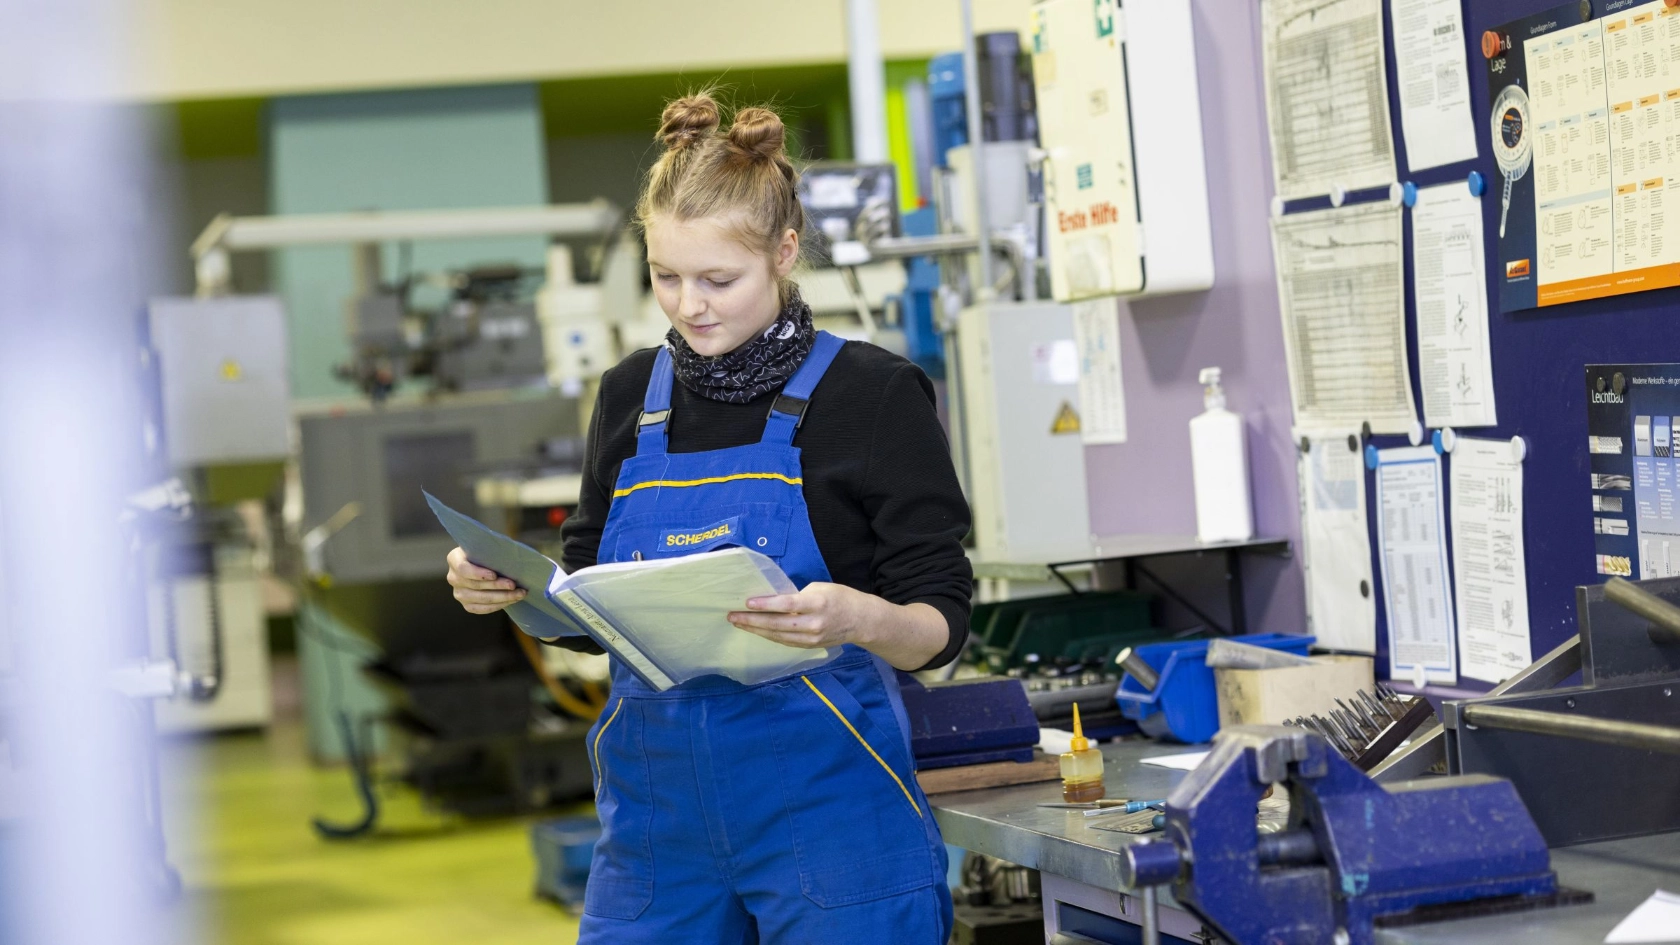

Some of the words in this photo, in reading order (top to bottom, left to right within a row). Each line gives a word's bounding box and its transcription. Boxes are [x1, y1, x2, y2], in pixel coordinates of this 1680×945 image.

[1491, 58, 1506, 74] Lage
[1058, 210, 1087, 233] Erste
[1090, 202, 1118, 226] Hilfe
[666, 523, 731, 546] SCHERDEL
